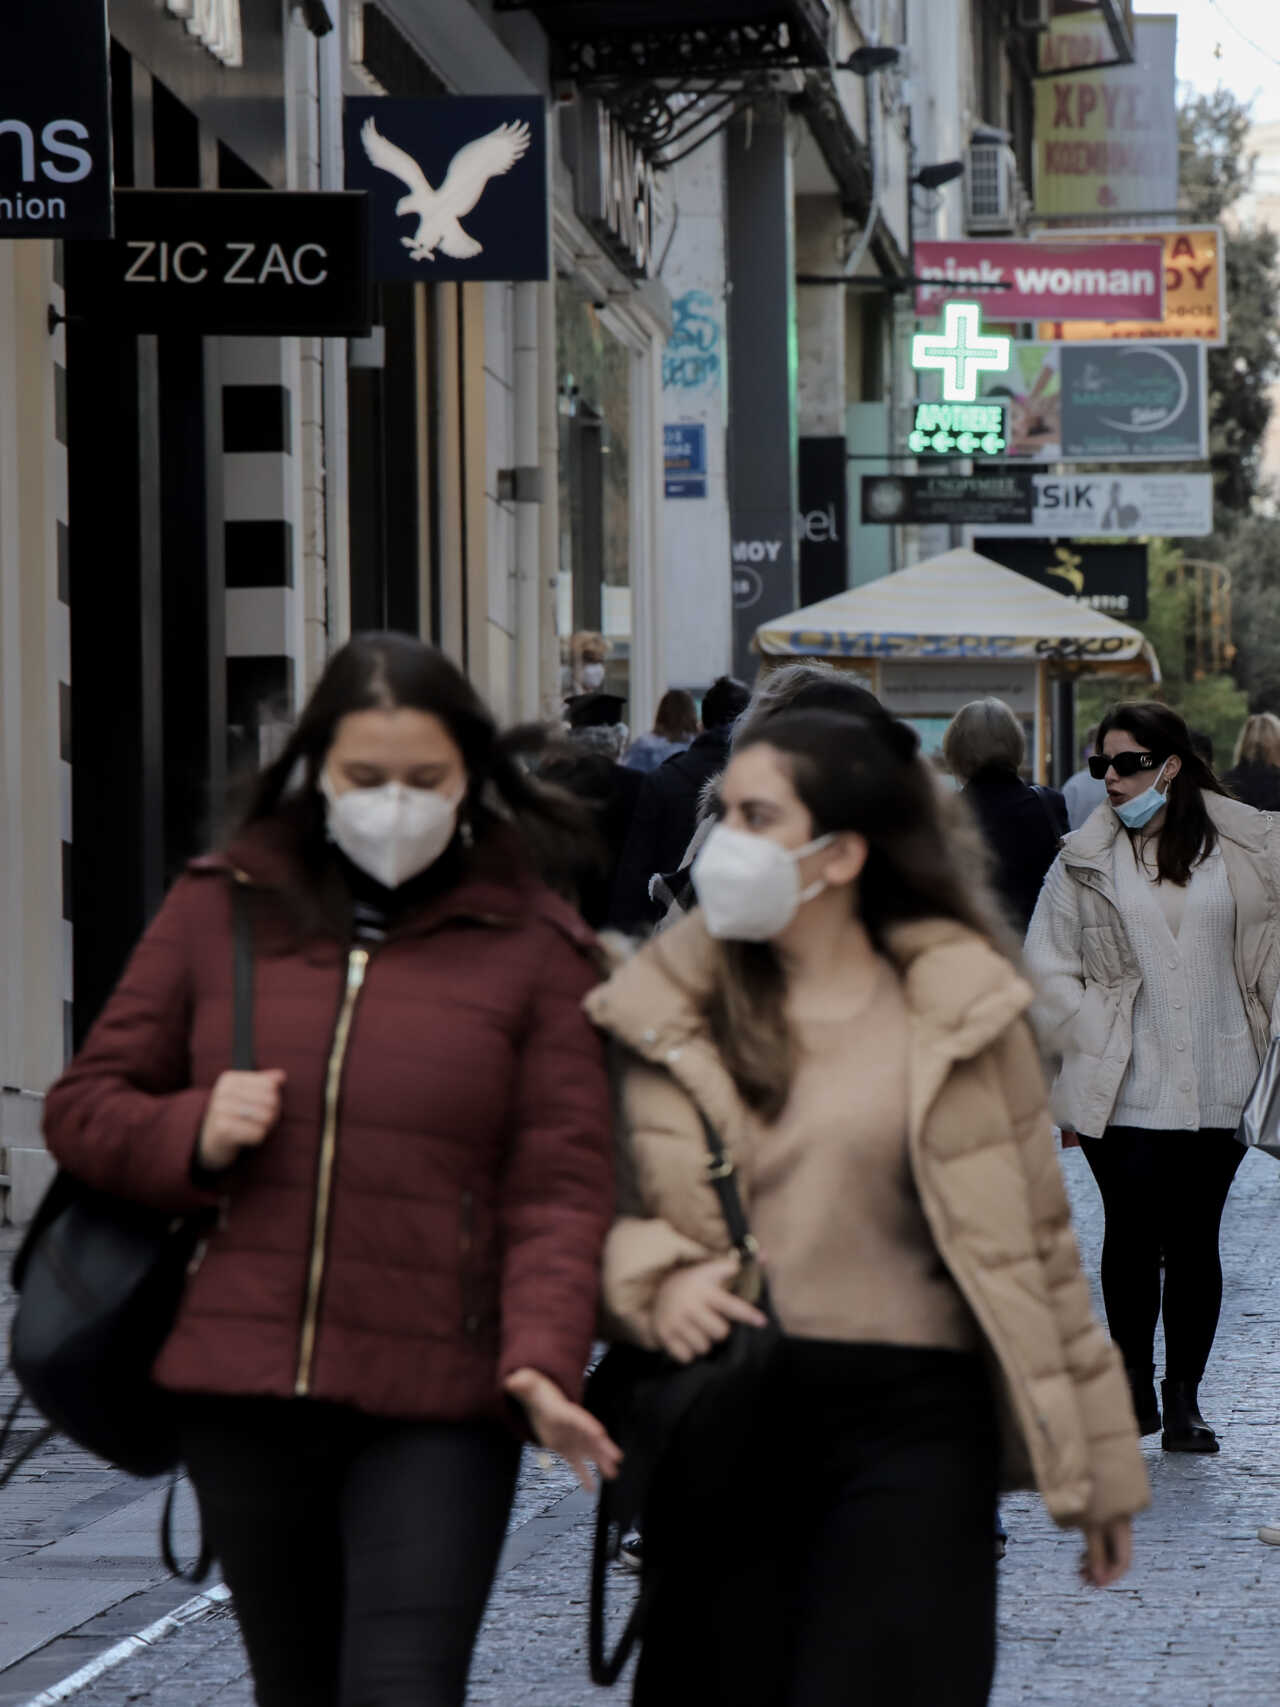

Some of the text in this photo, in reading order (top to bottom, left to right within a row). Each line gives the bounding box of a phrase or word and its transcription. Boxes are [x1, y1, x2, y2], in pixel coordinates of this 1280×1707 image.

[124, 241, 328, 285] ZIC ZAC
[1014, 266, 1155, 295] woman
